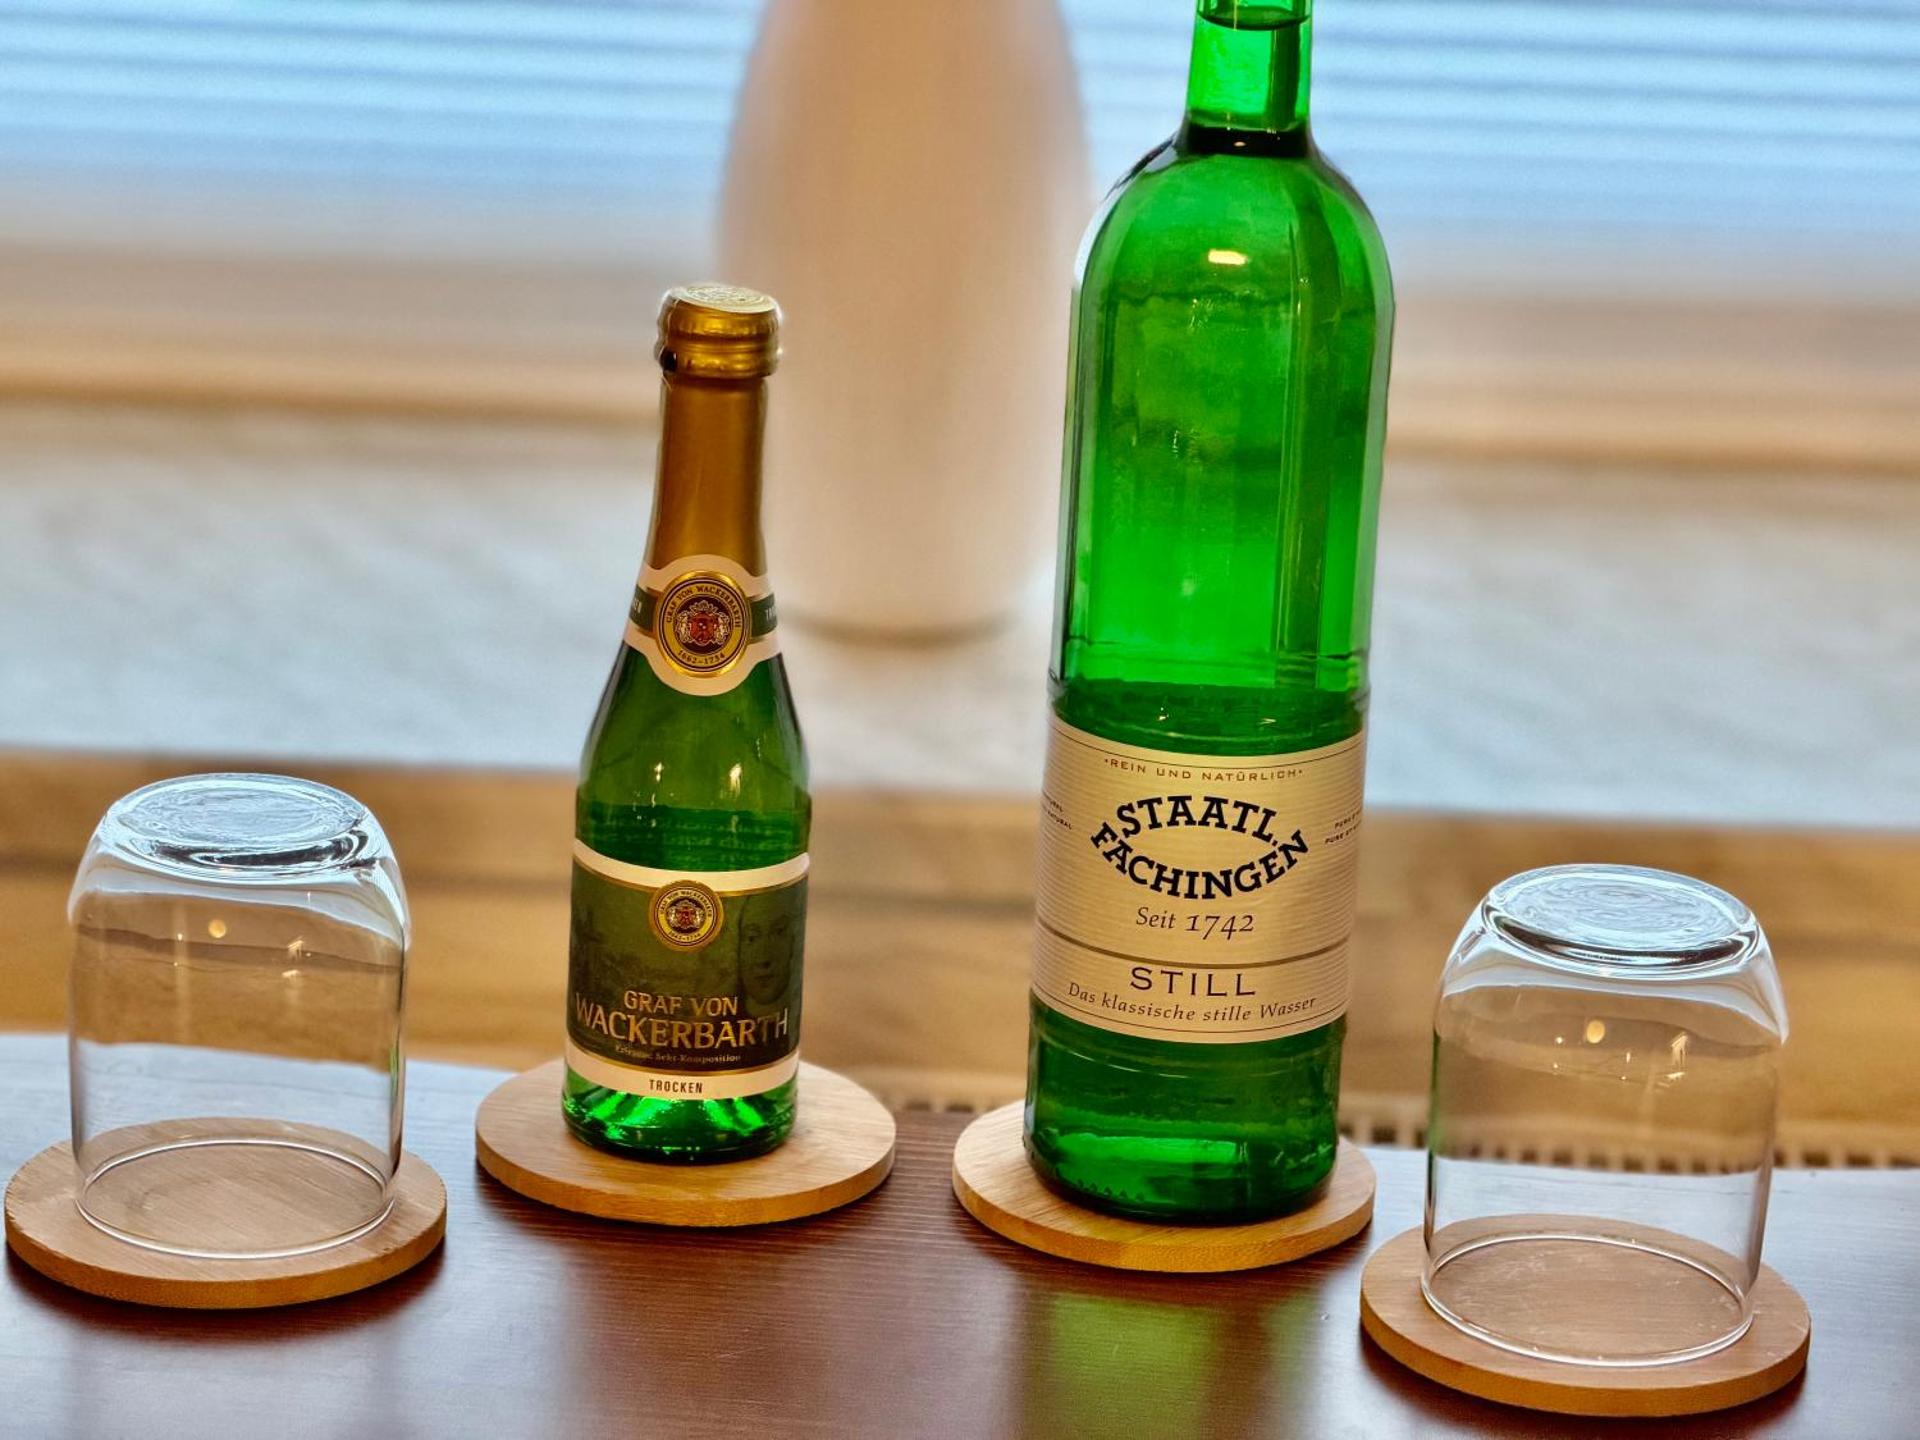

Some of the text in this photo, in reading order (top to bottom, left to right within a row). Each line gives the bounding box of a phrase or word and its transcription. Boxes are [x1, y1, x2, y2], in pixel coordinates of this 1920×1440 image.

[1156, 767, 1192, 780] UND
[1116, 795, 1278, 846] STAATL.
[1090, 822, 1309, 900] FACHINGEN
[1135, 906, 1255, 940] Seit 1742
[1130, 966, 1256, 997] STILL
[623, 989, 739, 1018] GRAF VON
[1068, 982, 1317, 1022] Das klassische stille Wasser
[575, 991, 789, 1049] WACKERBARTH
[649, 1078, 704, 1094] TROCKEN
